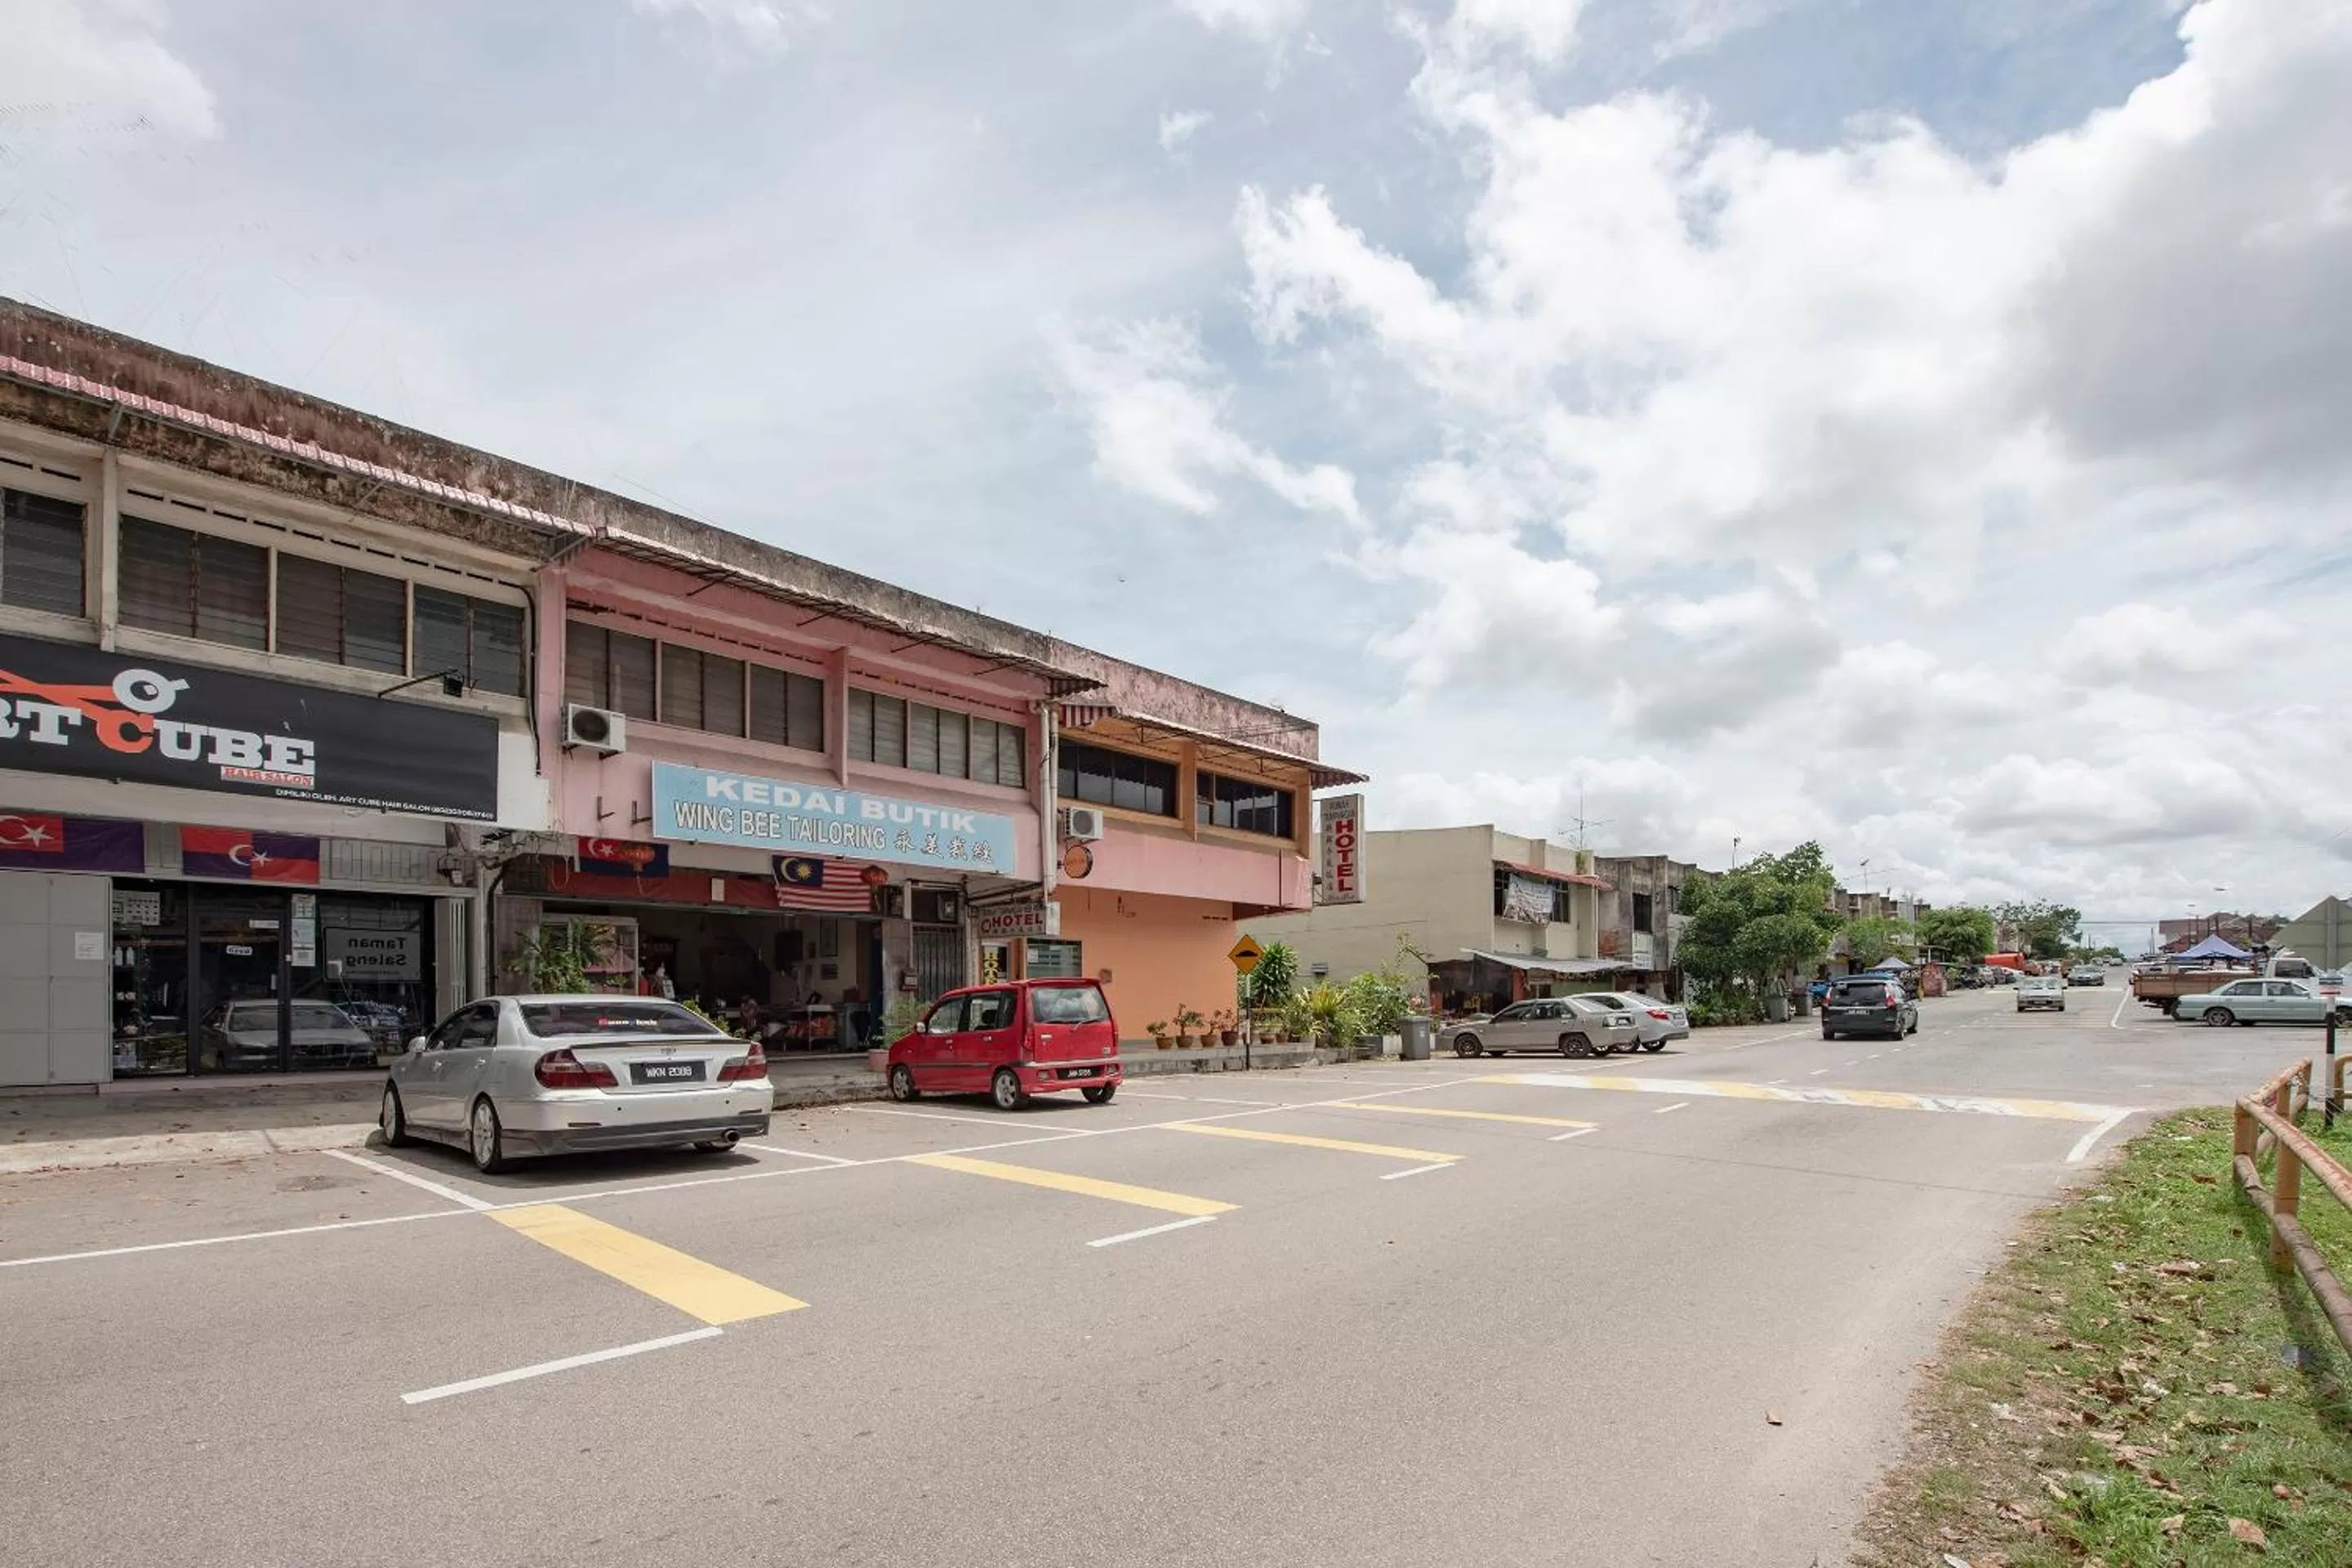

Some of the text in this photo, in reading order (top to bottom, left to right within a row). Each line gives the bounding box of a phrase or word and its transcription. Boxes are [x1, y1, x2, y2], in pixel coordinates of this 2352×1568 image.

[96, 710, 315, 775] CUBE
[225, 767, 312, 786] HAIR SALON
[338, 795, 357, 804] ART
[359, 797, 381, 806] CUBE
[706, 776, 977, 834] KEDAI BUTIK
[674, 800, 886, 849] WING BEE TAILORING
[1335, 818, 1356, 892] HOTEL
[991, 913, 1043, 928] HOTEL
[645, 1067, 666, 1078] WKN
